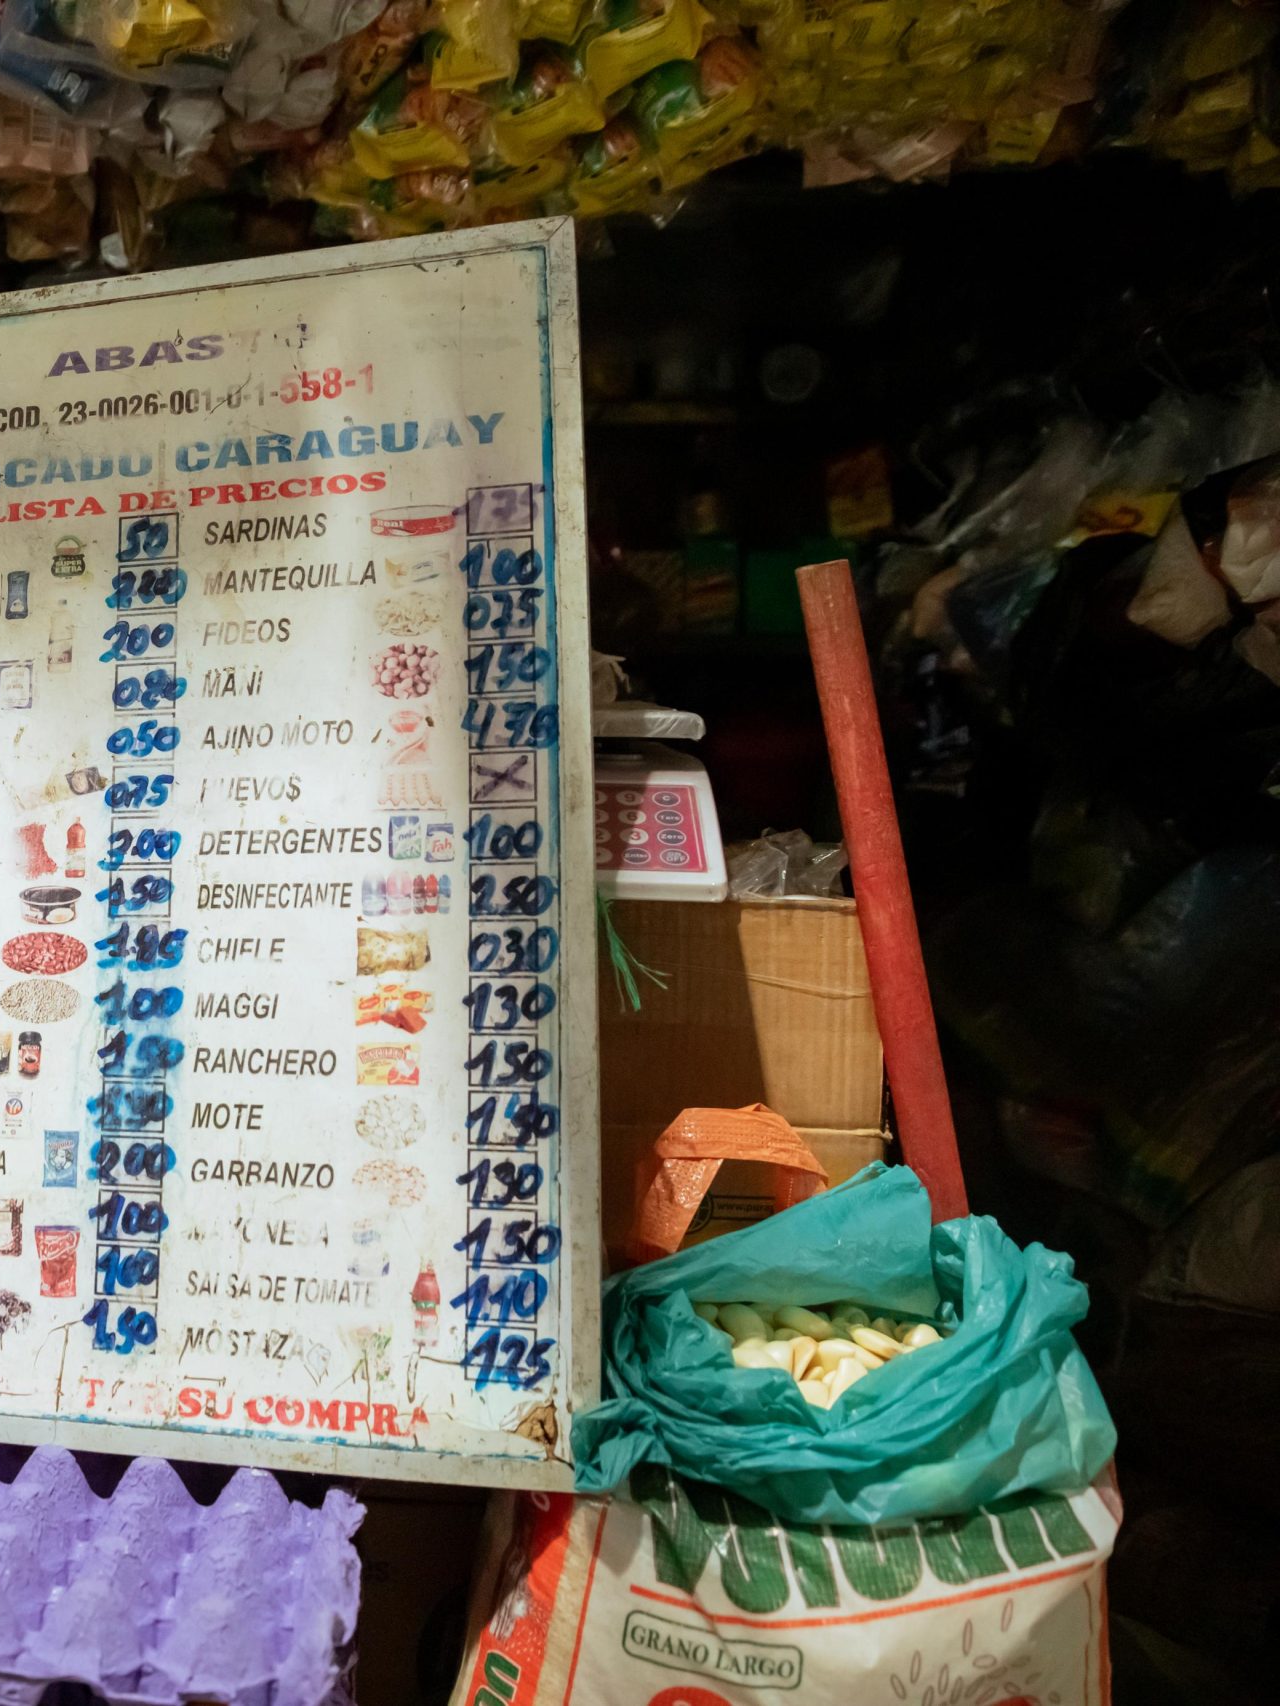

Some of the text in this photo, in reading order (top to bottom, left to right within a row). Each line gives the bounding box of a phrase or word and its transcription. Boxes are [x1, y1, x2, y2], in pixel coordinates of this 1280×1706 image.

[175, 412, 506, 472] CARAGUAY
[118, 489, 176, 513] DE
[189, 471, 388, 507] PRECIOS
[205, 513, 327, 545] SARDINAS
[203, 560, 377, 596] MANTEQUILLA
[203, 617, 292, 647] FIDEOS
[201, 719, 354, 750] AJINO MOTO
[198, 826, 383, 856] DETERGENTES
[197, 883, 353, 910] DESINFECTANTE
[194, 992, 280, 1020] MAGGI
[193, 1048, 337, 1078] RANCHERO
[191, 1103, 264, 1131] MOTE
[191, 1158, 335, 1189] GARBANZO
[260, 1275, 286, 1303] DE
[293, 1277, 377, 1309] TOMATE
[178, 1387, 233, 1421] SU
[630, 1625, 795, 1679] GRANO LARGO
